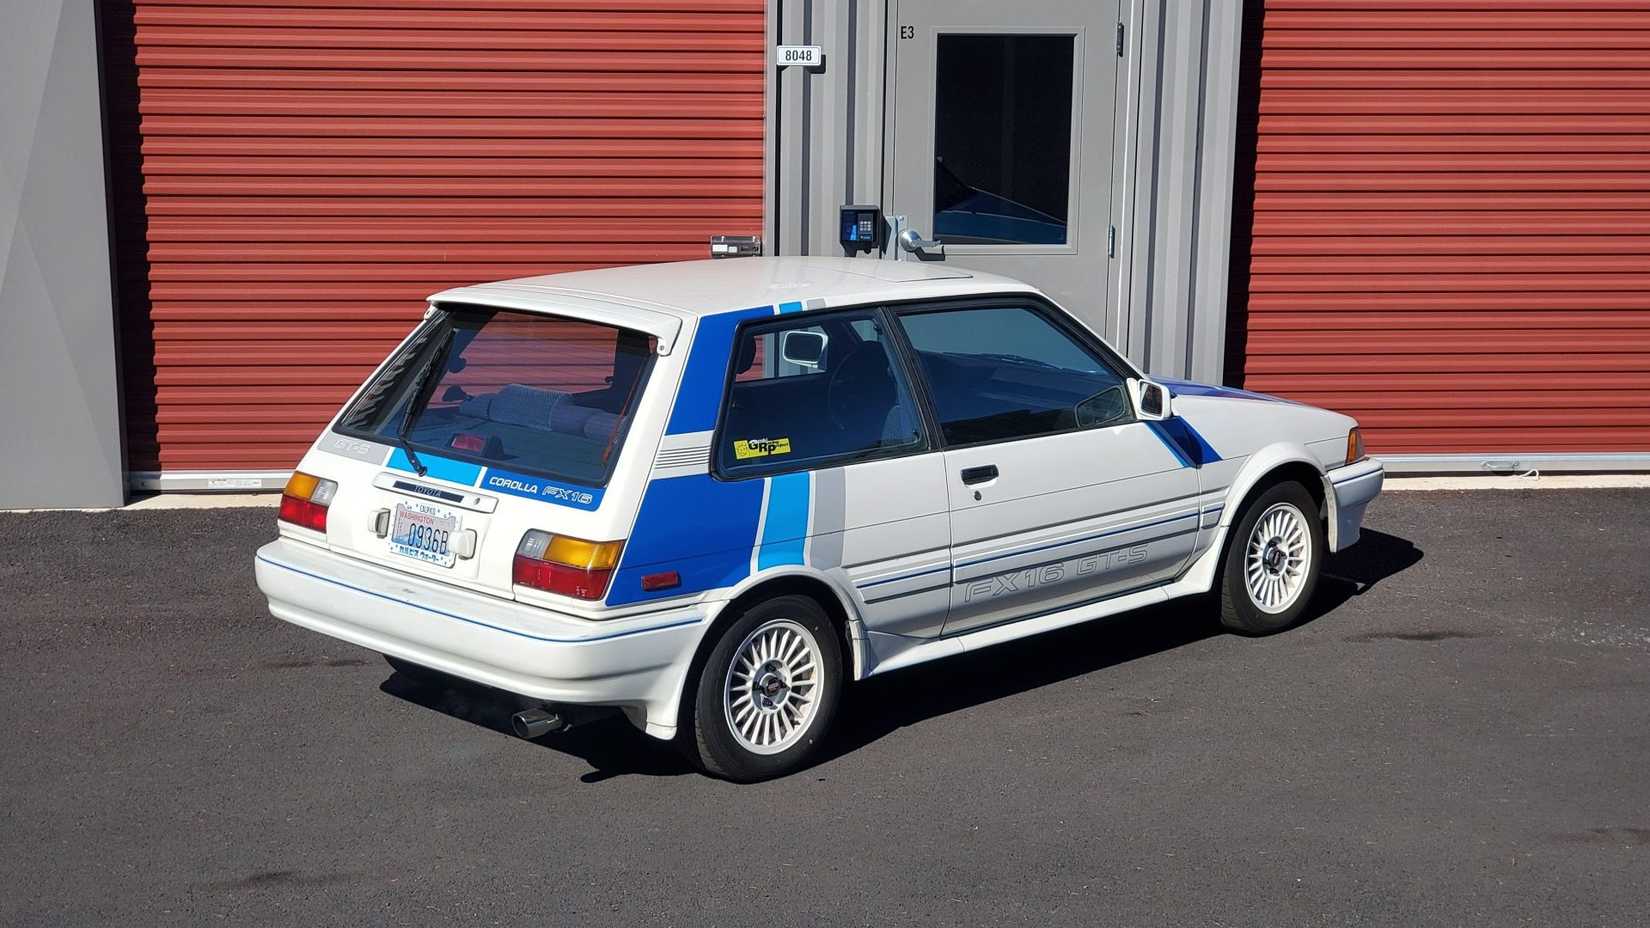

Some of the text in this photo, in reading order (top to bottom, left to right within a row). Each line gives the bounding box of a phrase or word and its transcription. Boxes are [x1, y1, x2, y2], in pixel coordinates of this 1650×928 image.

[900, 25, 915, 40] E3
[785, 50, 812, 61] 8048
[414, 484, 442, 498] TOYOTA
[489, 476, 593, 505] COROLLA FX16
[399, 511, 433, 525] WASHINGTON
[407, 522, 449, 555] 0936B
[964, 543, 1151, 603] FX16 GT-S
